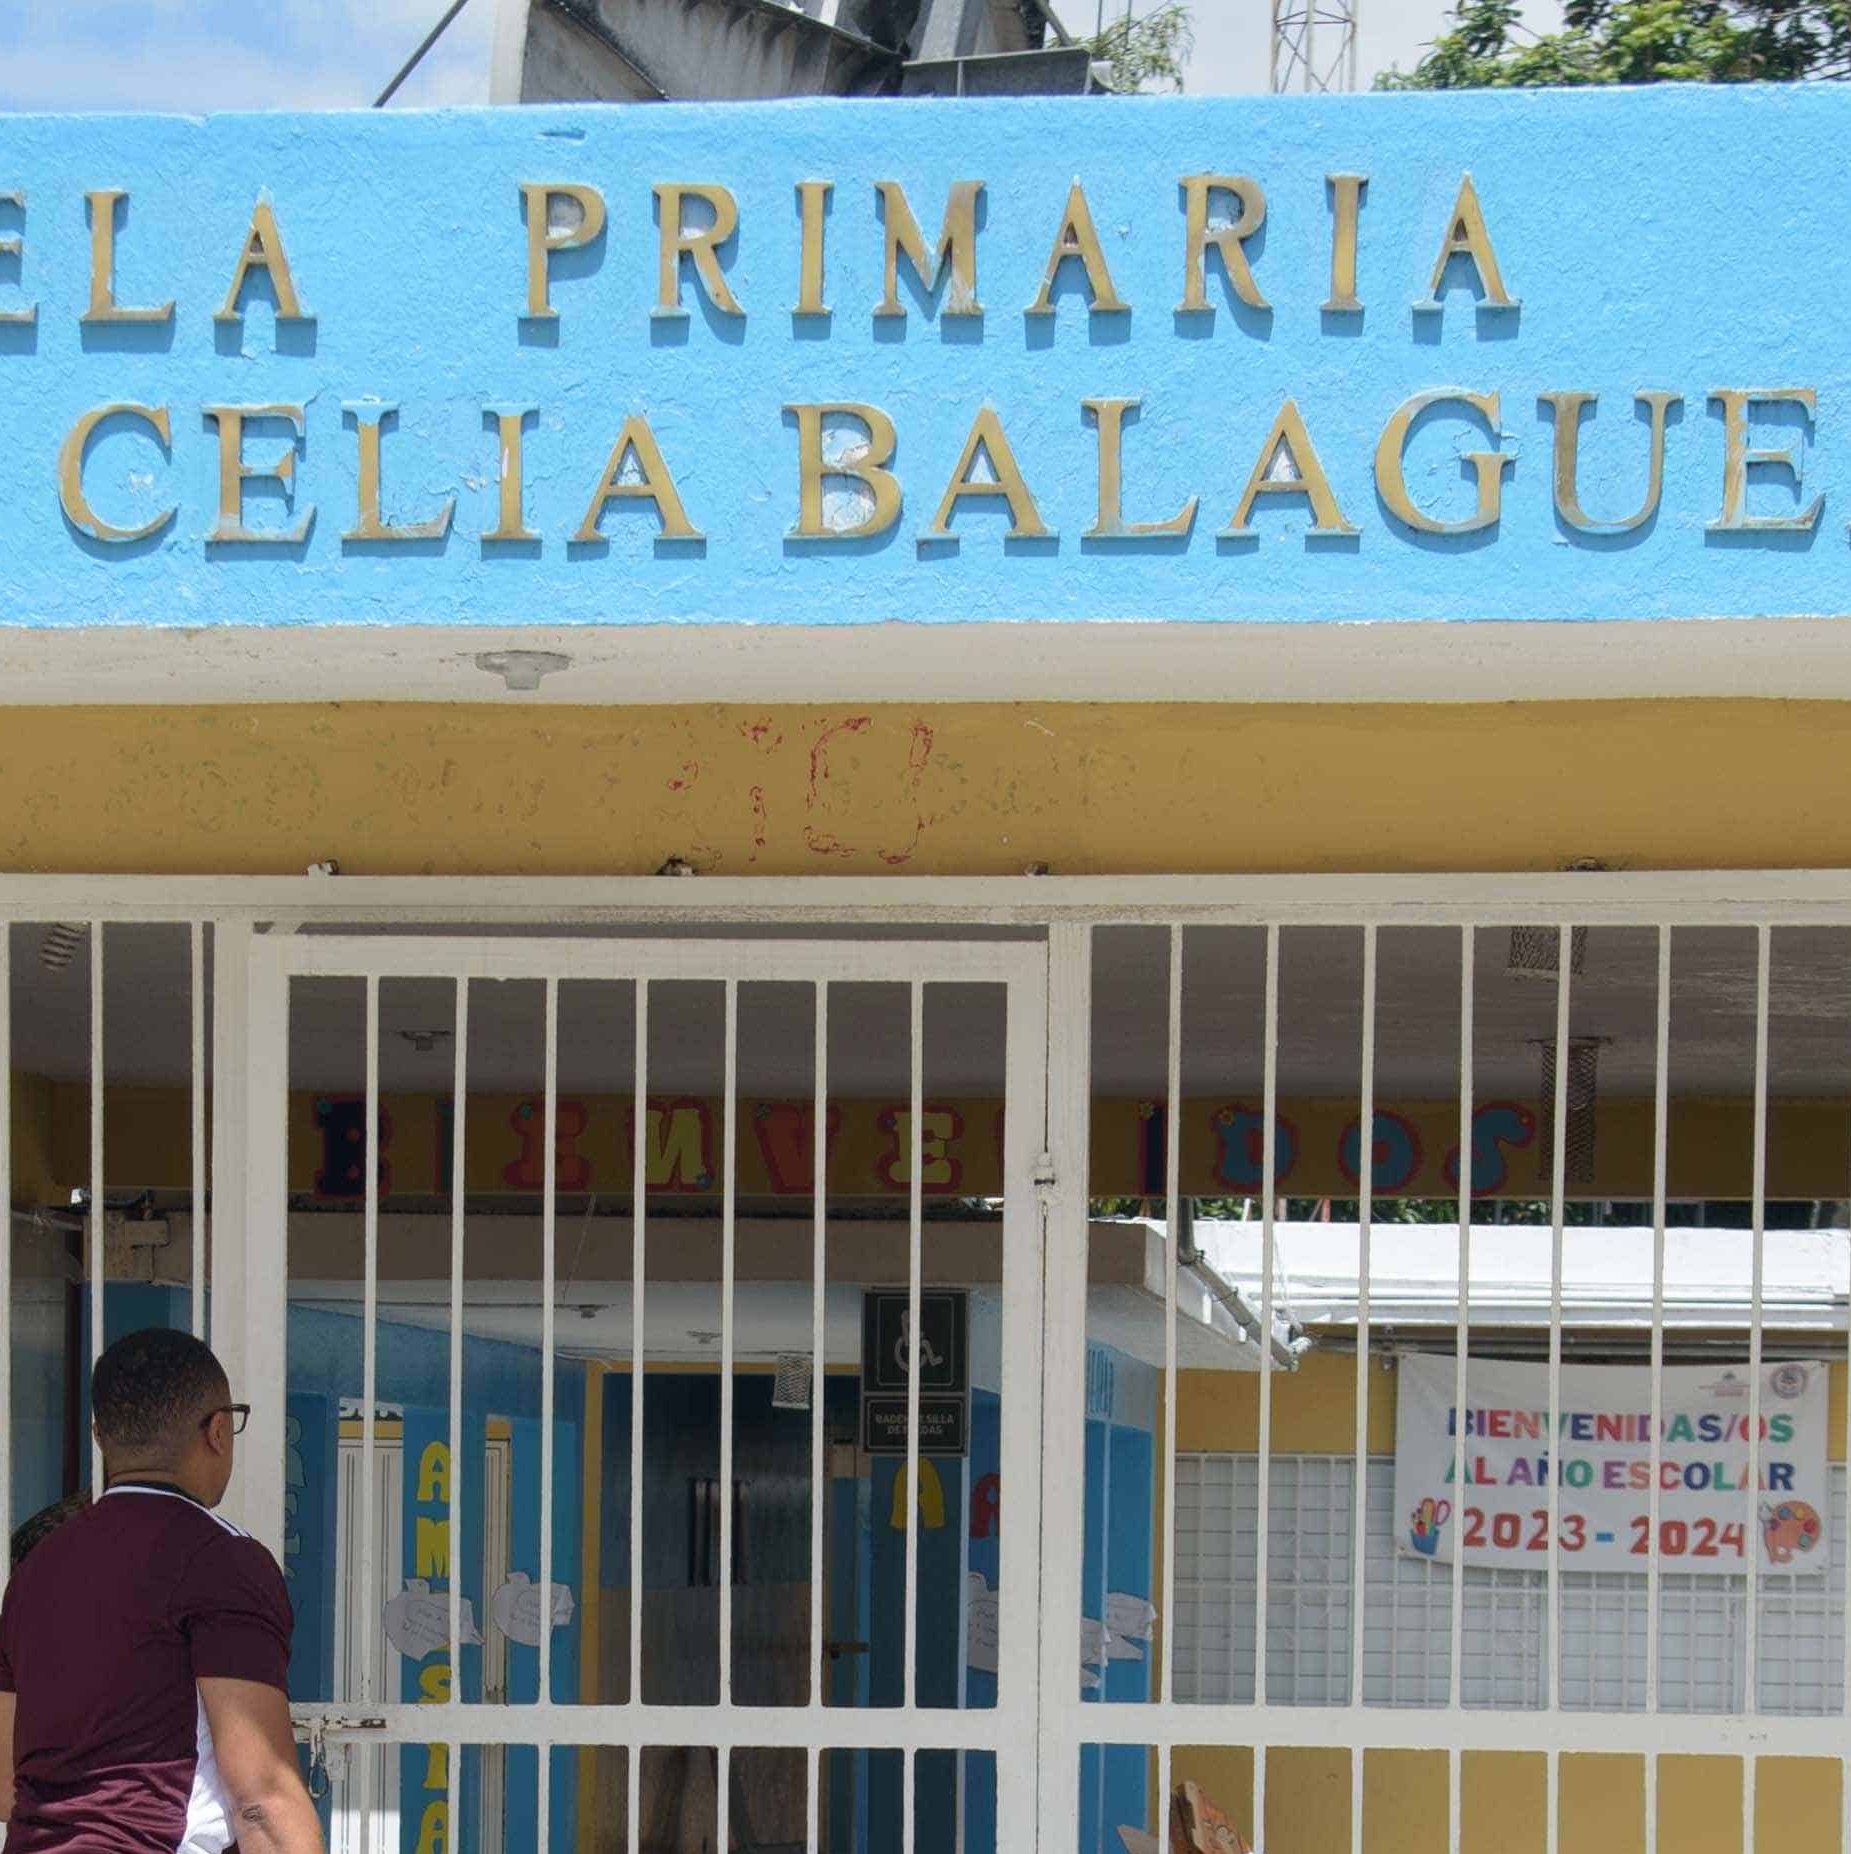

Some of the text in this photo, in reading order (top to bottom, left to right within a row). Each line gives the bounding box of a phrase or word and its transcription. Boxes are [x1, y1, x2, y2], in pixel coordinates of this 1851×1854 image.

[518, 171, 1521, 320] PRIMARIA
[58, 401, 707, 546] CELIA
[309, 1096, 1537, 1199] BIENVEIDOS
[1448, 1407, 1795, 1443] BIENVENIDAS/OS
[1444, 1451, 1795, 1492] AL AÑO ESCOLAR
[1463, 1507, 1588, 1553] 2023
[1629, 1515, 1748, 1558] 2024
